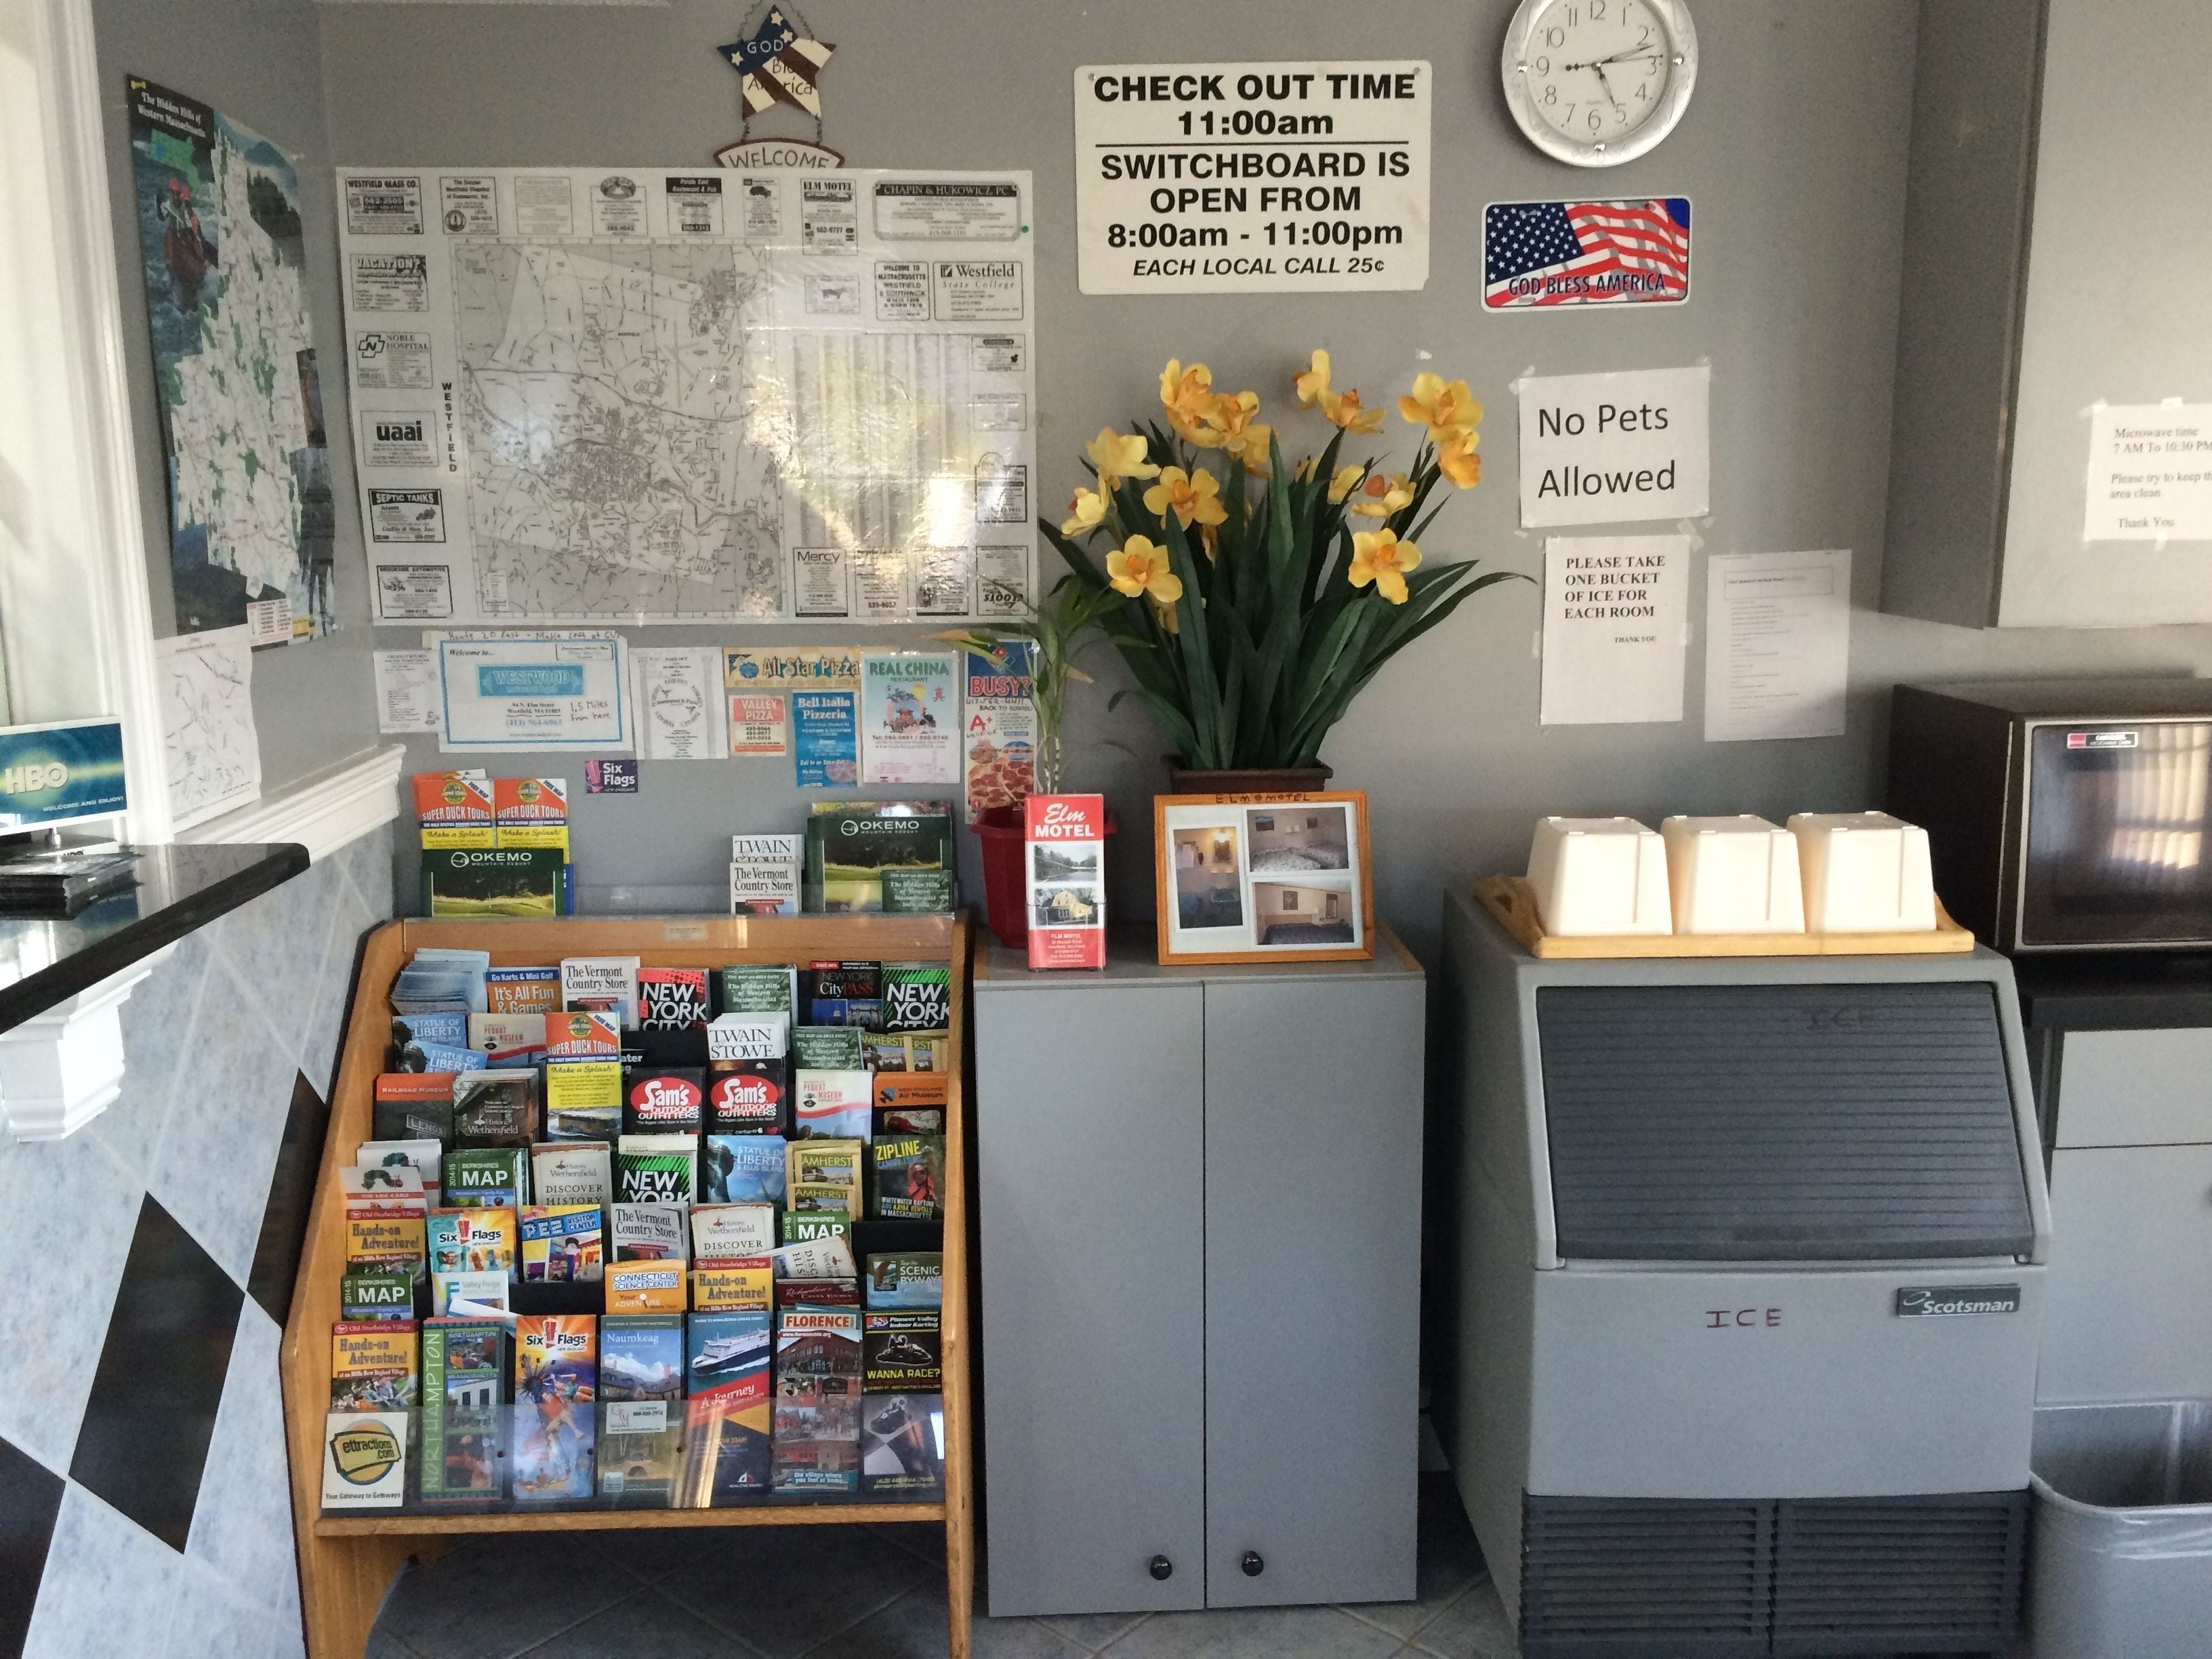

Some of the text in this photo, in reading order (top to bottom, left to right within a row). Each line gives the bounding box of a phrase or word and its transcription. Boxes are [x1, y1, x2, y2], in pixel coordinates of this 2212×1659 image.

[1568, 7, 1578, 26] 11
[1590, 1, 1605, 20] 12
[1622, 7, 1626, 26] 1
[1546, 27, 1564, 47] 10
[1637, 26, 1650, 46] 2
[747, 39, 783, 54] GOD
[1536, 56, 1549, 76] 9
[1647, 55, 1658, 75] 3
[1094, 73, 1415, 102] CHECK OUT TIME
[1544, 85, 1557, 105] 8
[1635, 83, 1647, 101] 4
[1565, 104, 1576, 123] 7
[1588, 109, 1601, 129] 6
[1614, 103, 1626, 123] 5
[1179, 110, 1333, 136] 11:00am
[729, 146, 830, 168] WELCOME
[1101, 152, 1410, 180] SWITCHBOARD IS
[407, 180, 419, 188] CO.
[824, 182, 853, 191] MOTEL
[884, 185, 922, 194] CHAPIN
[1150, 186, 1361, 213] OPEN FROM
[1107, 221, 1402, 251] 8:00am 11:00pm
[357, 258, 420, 270] VACATION?
[956, 263, 1015, 278] Westfield
[1133, 257, 1385, 276] EACH LOCAL CALL 25¢
[943, 280, 1015, 289] State College
[1509, 272, 1665, 296] GOD BLESS AMERICA
[387, 342, 428, 350] HOSPITAL
[1539, 404, 1670, 438] No Pets
[376, 421, 423, 442] uaai
[2114, 428, 2199, 439] Microwave time
[2114, 441, 2212, 453] 7 AM To 10:30 PM
[1537, 459, 1676, 499] Allowed
[2111, 472, 2201, 485] Please try to keep
[375, 493, 434, 504] SEPTIC TANKS
[2110, 490, 2131, 499] area
[2118, 517, 2175, 529] Thank You
[797, 550, 840, 565] Mercy
[1565, 555, 1666, 569] PLEASE TAKE
[1565, 572, 1660, 586] ONE BUCKET
[1564, 589, 1647, 602] OF ICE FOR
[1564, 605, 1655, 619] EACH ROOM
[1614, 635, 1657, 644] THANK YOU
[762, 657, 861, 676] All Star Pizza
[869, 661, 949, 676] REAL CHINA
[491, 669, 571, 684] WESTWOOD
[970, 675, 1032, 697] BUSY?
[571, 700, 608, 712] 1.5 Miles
[741, 699, 777, 710] VALLEY
[798, 697, 851, 708] Bell Italia
[593, 712, 611, 720] here
[745, 711, 773, 721] PIZZA
[802, 709, 846, 720] Pizzeria
[602, 762, 622, 774] Six
[5, 762, 68, 795] HBO
[605, 774, 636, 788] Flags
[43, 796, 124, 813] WELCOME AND ENJOY!
[422, 806, 490, 821] SUPER DUCK TOURS
[1044, 802, 1086, 825] Elm
[860, 821, 920, 830] OKEMO
[1035, 824, 1095, 838] MOTEL
[471, 852, 532, 862] OKEMO
[735, 867, 789, 880] The Vermont
[735, 880, 793, 893] Country Store
[495, 985, 554, 1001] It's All Fun
[642, 982, 695, 1002] NEW
[887, 983, 943, 1002] NEW
[649, 1002, 707, 1021] YORK
[710, 1027, 773, 1043] TWAIN
[711, 1044, 775, 1059] STOWE
[639, 1080, 690, 1111] Sam's
[876, 1140, 922, 1161] ZIPLINE
[802, 1156, 853, 1167] AMHERST
[462, 1170, 508, 1187] MAP
[621, 1170, 679, 1191] NEW
[546, 1185, 603, 1193] DISCOVER
[438, 1230, 501, 1243] Six Flags
[613, 1273, 678, 1283] CONNECTICUT
[899, 1266, 940, 1276] SCENIC
[613, 1280, 677, 1290] SCIENCE CENTER
[699, 1273, 747, 1286] Hands-on
[358, 1287, 405, 1303] MAP
[707, 1286, 766, 1301] Adventure!
[1921, 1298, 2015, 1315] Scotsman
[785, 1315, 850, 1328] FLORENCE
[1706, 1308, 1782, 1328] ICE
[526, 1333, 587, 1346] Six Flags
[607, 1333, 659, 1345] Naumkeag
[867, 1368, 941, 1379] WANNA RACE?
[711, 1382, 755, 1405] Journey
[424, 1332, 444, 1490] NORTHAMPTON
[377, 1449, 395, 1460] .com
